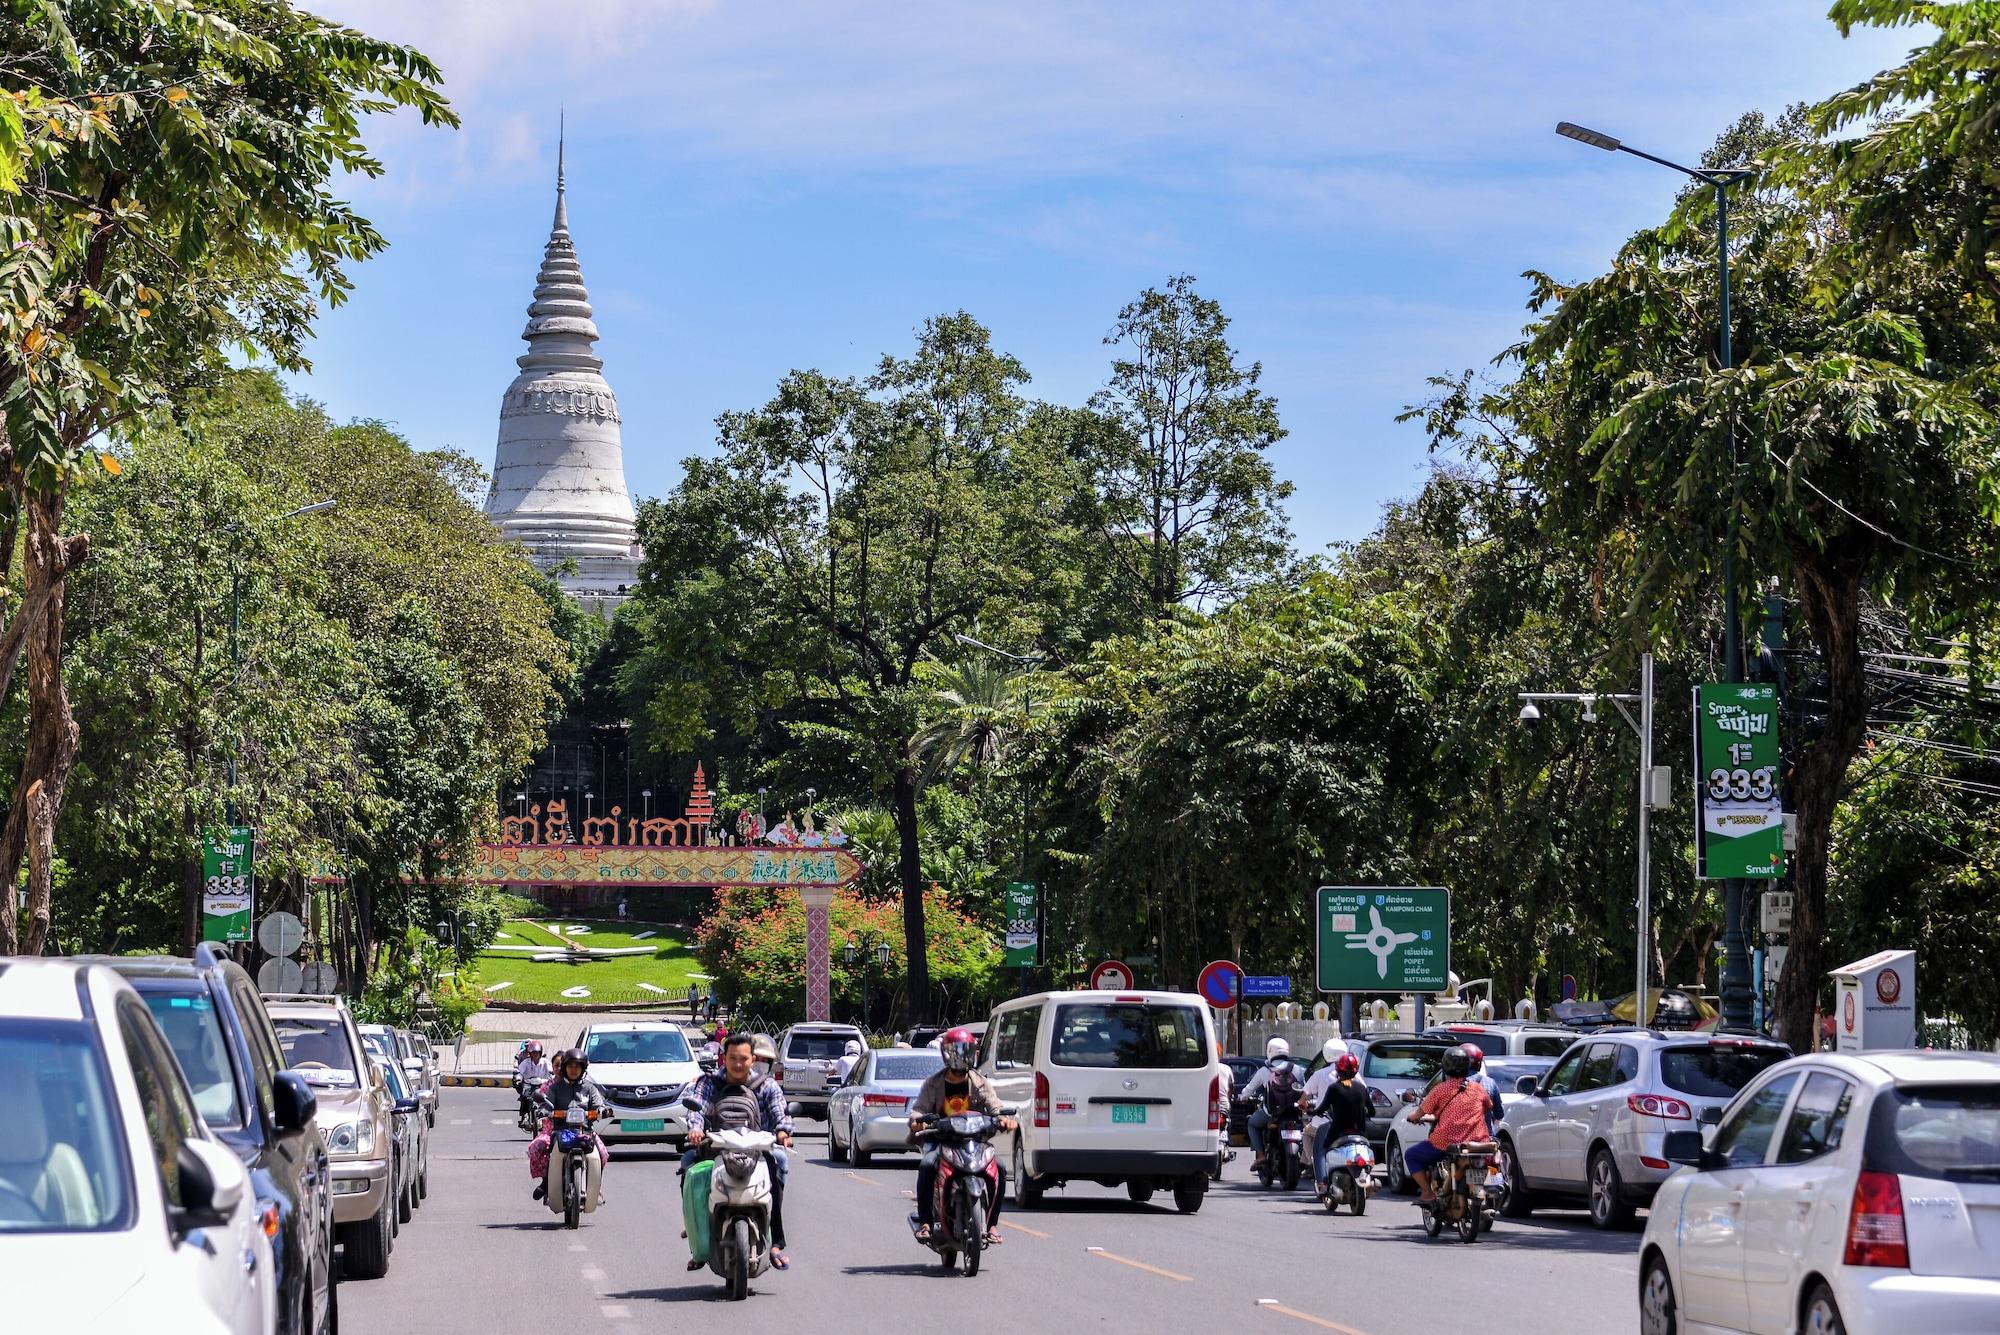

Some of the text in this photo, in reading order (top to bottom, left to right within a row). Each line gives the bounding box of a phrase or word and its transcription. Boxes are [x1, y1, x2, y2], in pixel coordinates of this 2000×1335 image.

[1708, 702, 1742, 715] Smart
[1710, 768, 1773, 800] 333
[1746, 864, 1775, 874] Smart
[207, 875, 245, 894] 333
[1009, 919, 1034, 933] 333
[226, 931, 245, 939] Smart
